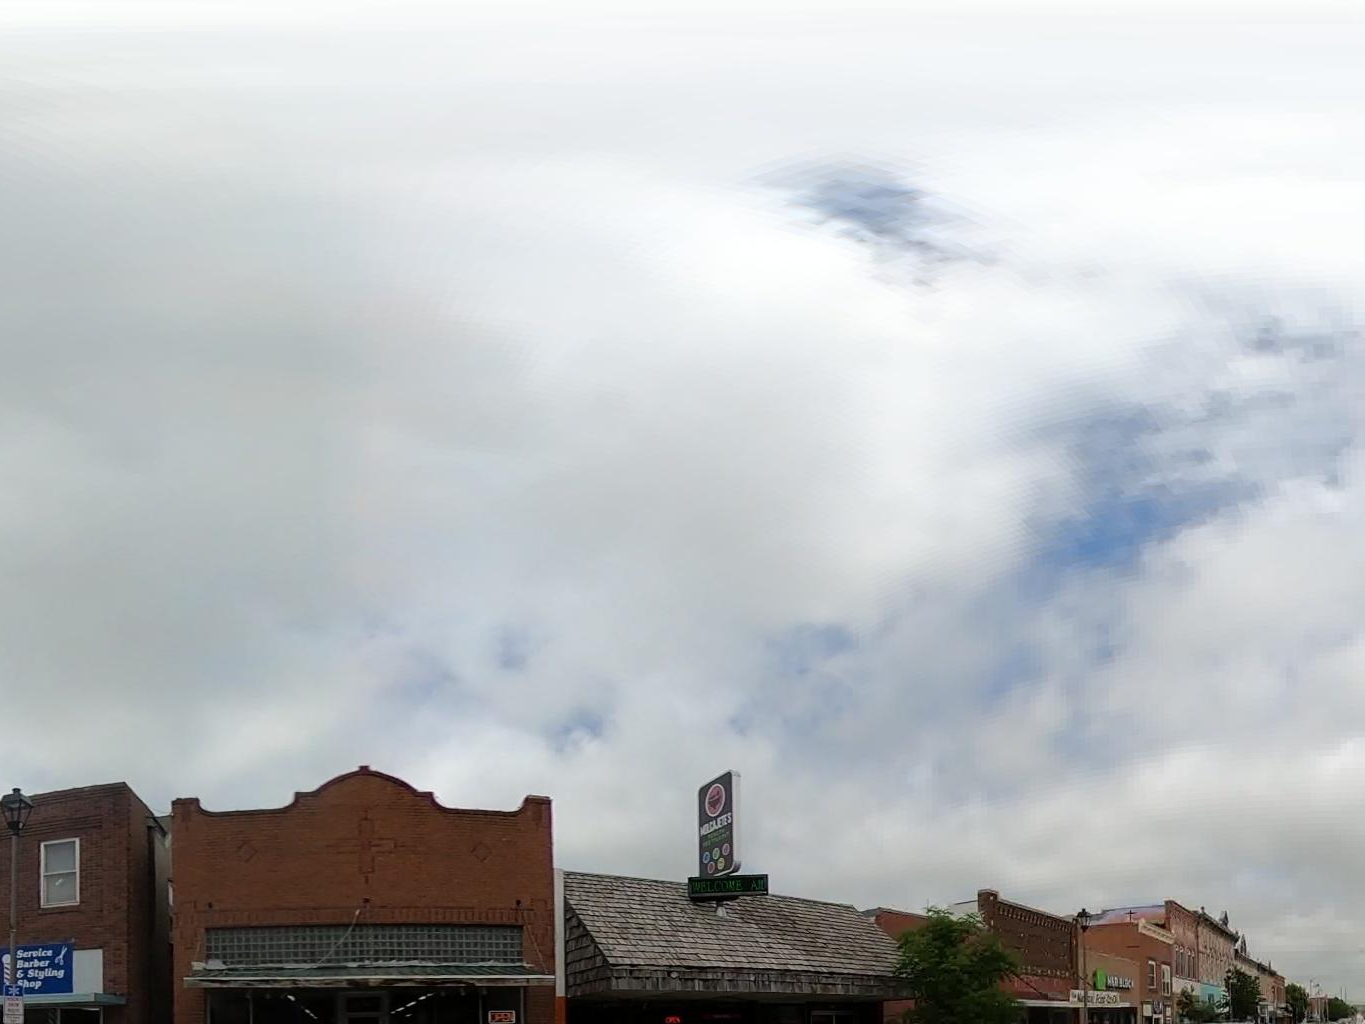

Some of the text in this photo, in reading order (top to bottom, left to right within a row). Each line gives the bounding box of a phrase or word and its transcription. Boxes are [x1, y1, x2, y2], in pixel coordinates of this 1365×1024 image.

[693, 881, 743, 893] WELCOME
[16, 948, 53, 959] Service
[16, 959, 51, 969] Barber
[16, 968, 66, 980] & Styling
[17, 979, 42, 989] Shop
